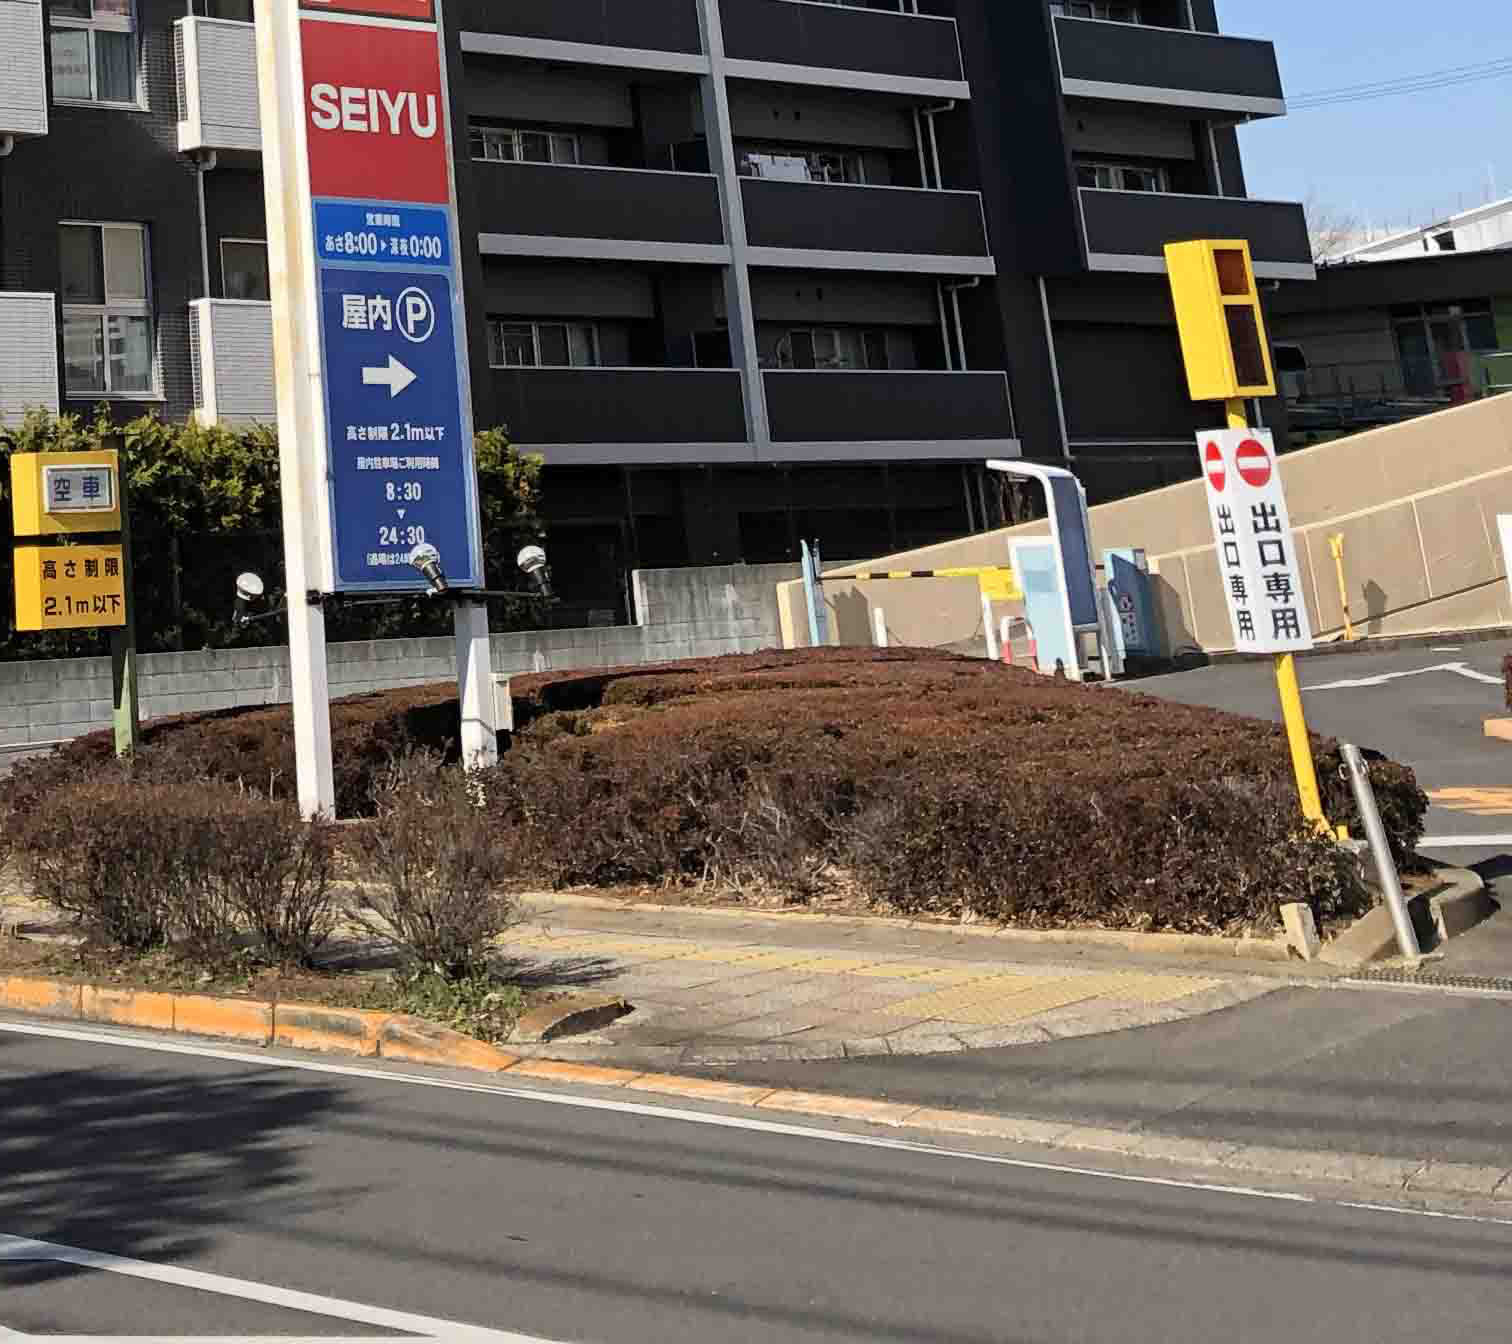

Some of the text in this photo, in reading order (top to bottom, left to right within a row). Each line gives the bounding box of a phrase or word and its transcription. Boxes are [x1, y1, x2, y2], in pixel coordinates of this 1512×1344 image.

[310, 82, 438, 139] SEIYU
[341, 292, 393, 330] 屋内
[53, 475, 102, 502] 空車
[385, 481, 422, 501] 8:30
[378, 525, 425, 545] 24:30
[42, 557, 120, 581] 高さ制限
[1216, 502, 1256, 641] 出口専用
[1250, 501, 1302, 640] 出口専用
[43, 593, 121, 617] 2.1m以下
